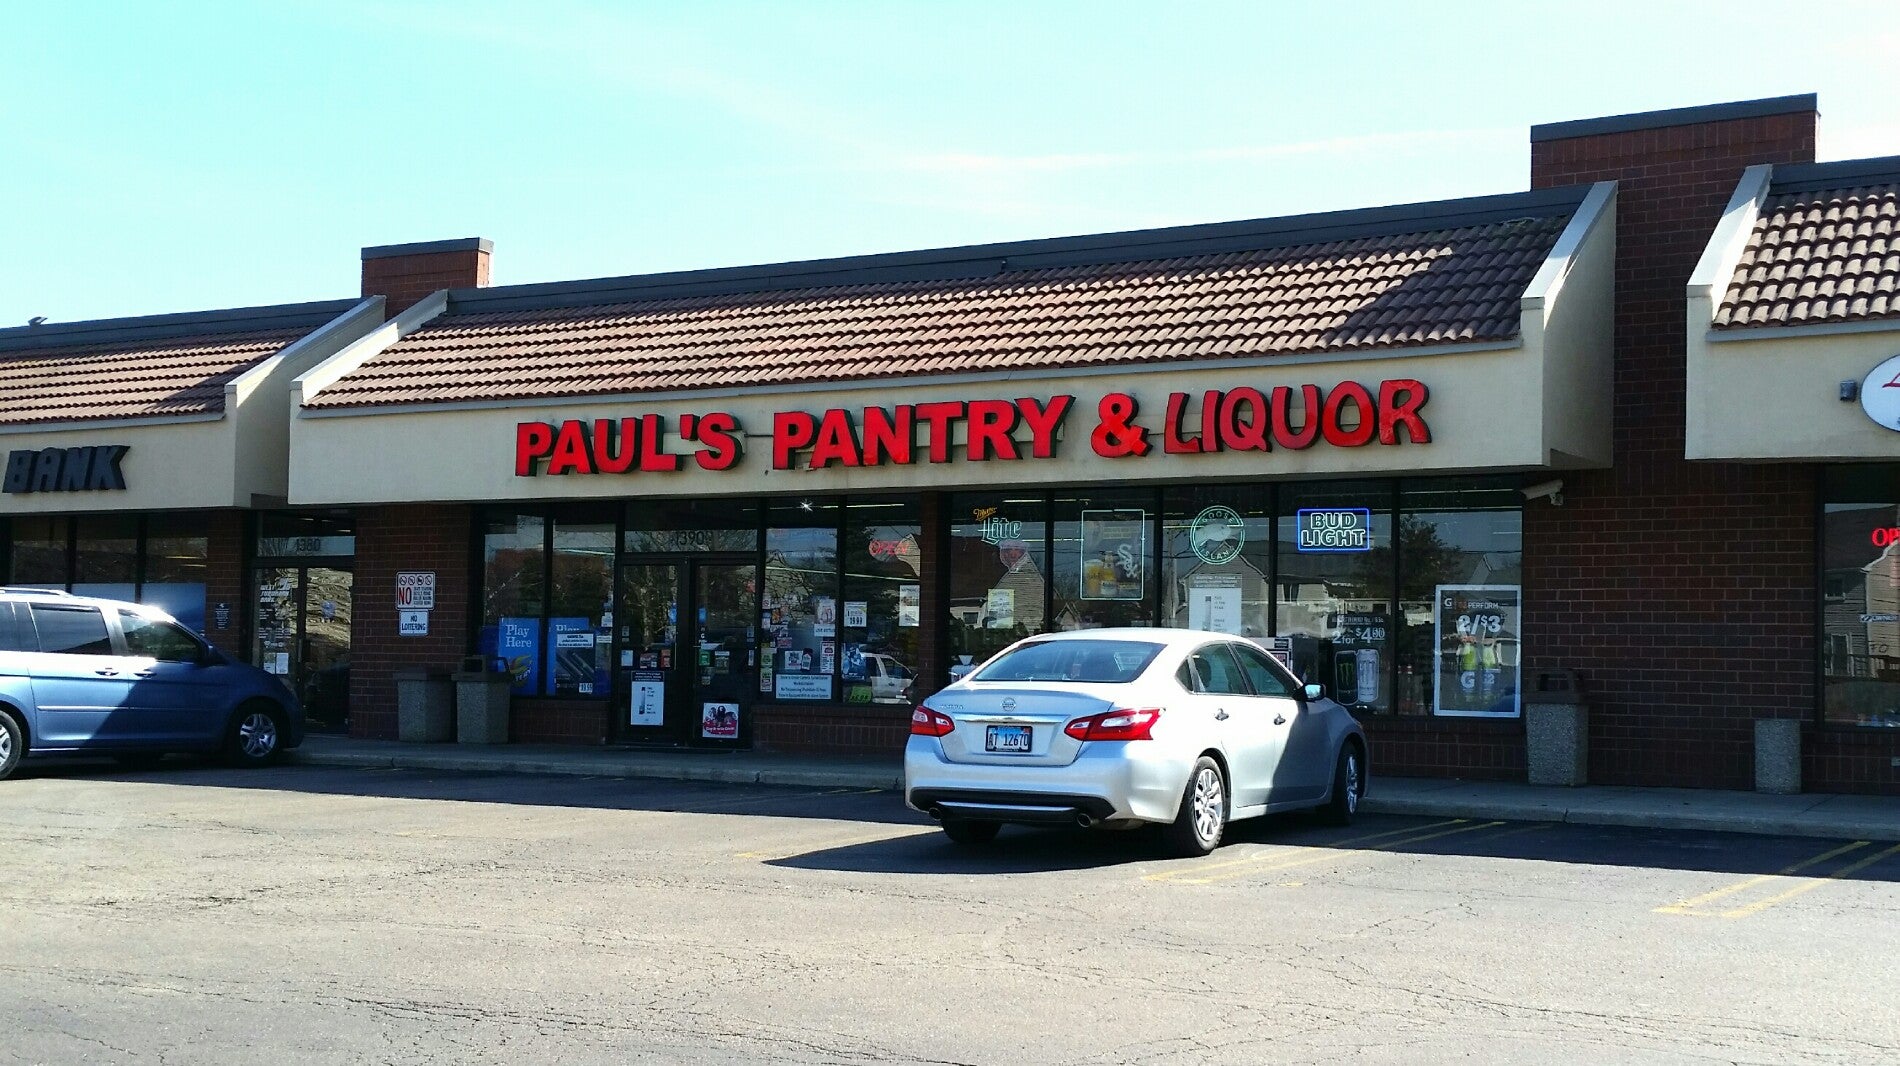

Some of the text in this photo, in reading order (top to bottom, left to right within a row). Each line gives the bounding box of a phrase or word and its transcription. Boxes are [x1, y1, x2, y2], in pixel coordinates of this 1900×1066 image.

[515, 379, 1432, 477] PAUL'S PANTRY & LIQUOR
[2, 445, 131, 494] BANK
[1202, 511, 1235, 523] GOOSE
[1310, 512, 1357, 529] BUD
[978, 517, 1022, 545] Lite
[1301, 529, 1366, 547] LIGHT
[296, 538, 321, 552] 1380
[1200, 546, 1235, 560] ISLAND
[399, 587, 412, 605] NO
[1467, 601, 1499, 609] PERFORM
[402, 623, 426, 631] LOITERING
[505, 624, 530, 638] Play
[1458, 614, 1502, 635] 2/$3
[505, 636, 532, 648] Here
[1342, 636, 1355, 644] for
[1003, 733, 1029, 747] 12670
